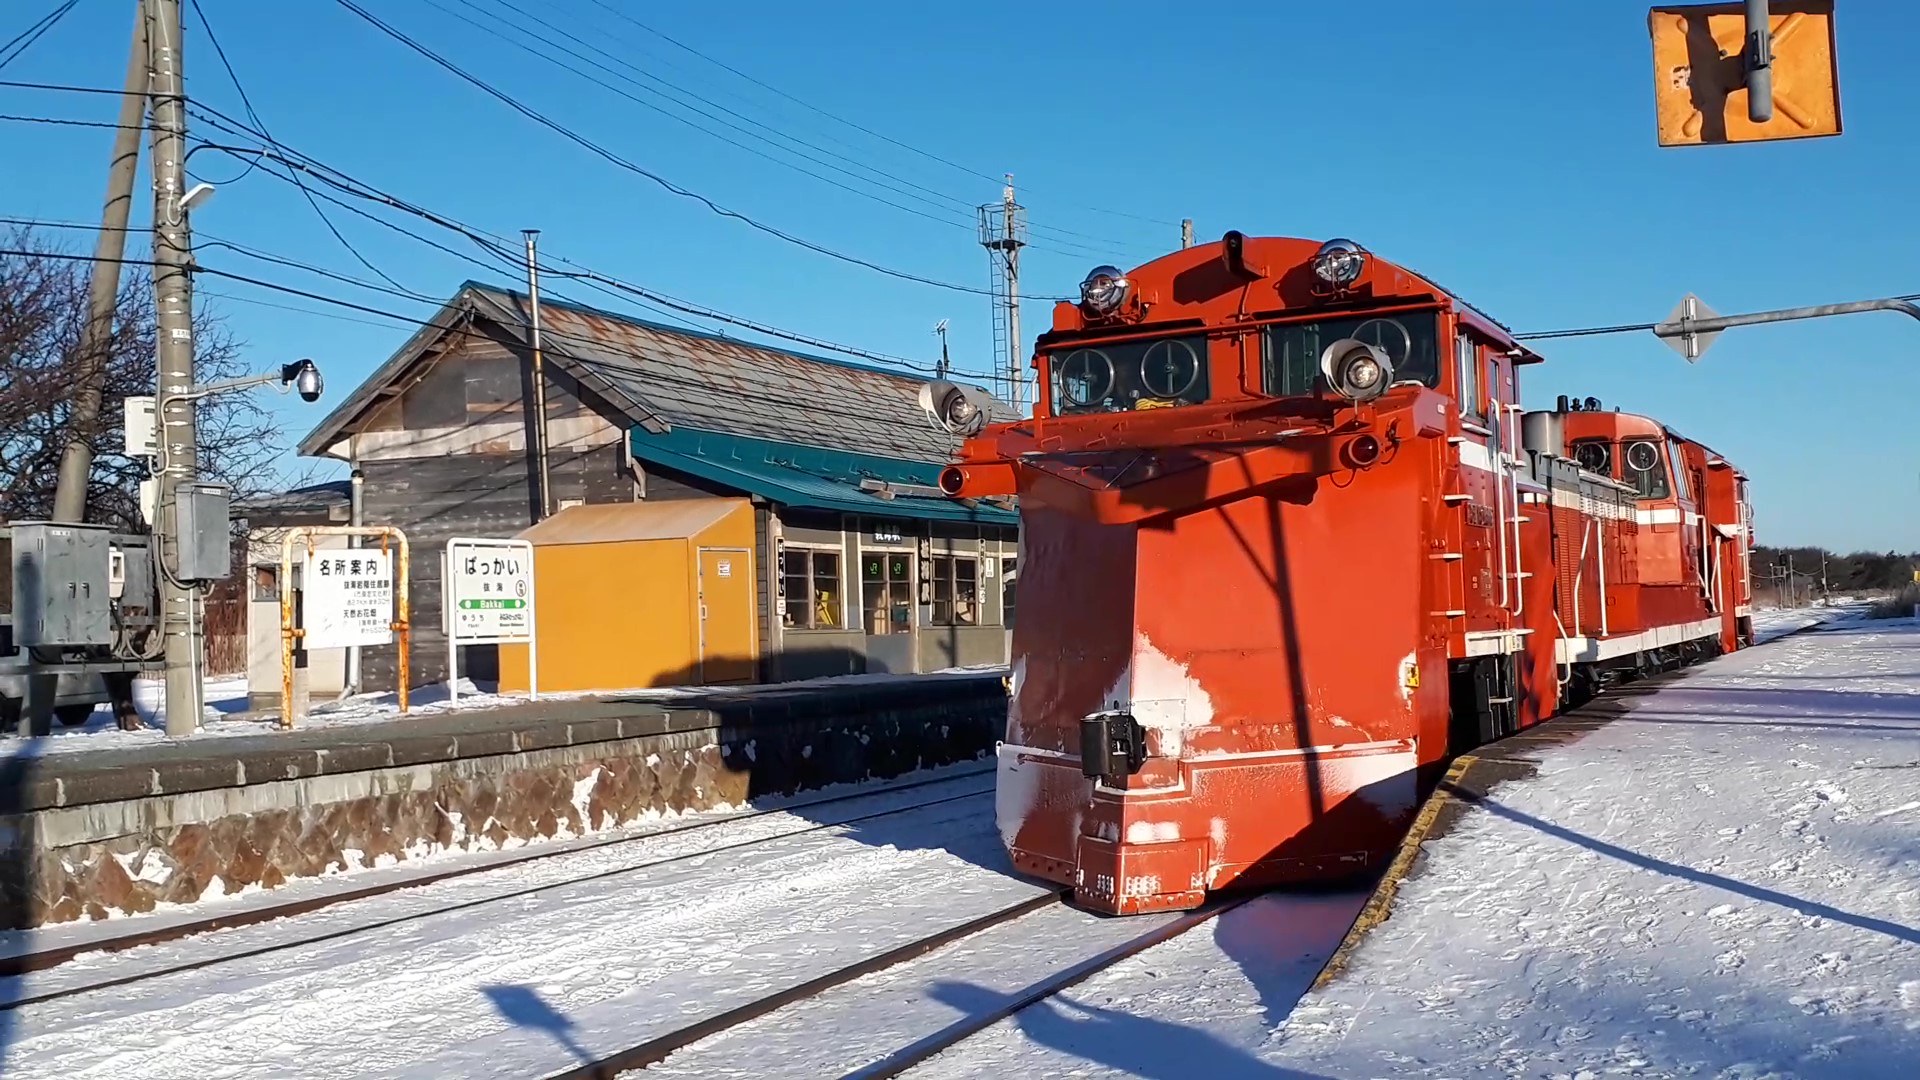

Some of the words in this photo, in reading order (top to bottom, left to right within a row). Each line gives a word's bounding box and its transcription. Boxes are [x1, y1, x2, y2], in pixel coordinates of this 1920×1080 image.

[319, 558, 378, 576] 名所案内
[465, 556, 520, 576] ばっかい
[869, 562, 878, 572] JR
[893, 562, 902, 572] JR
[479, 600, 505, 609] Bakkai
[461, 614, 485, 622] ゆうち
